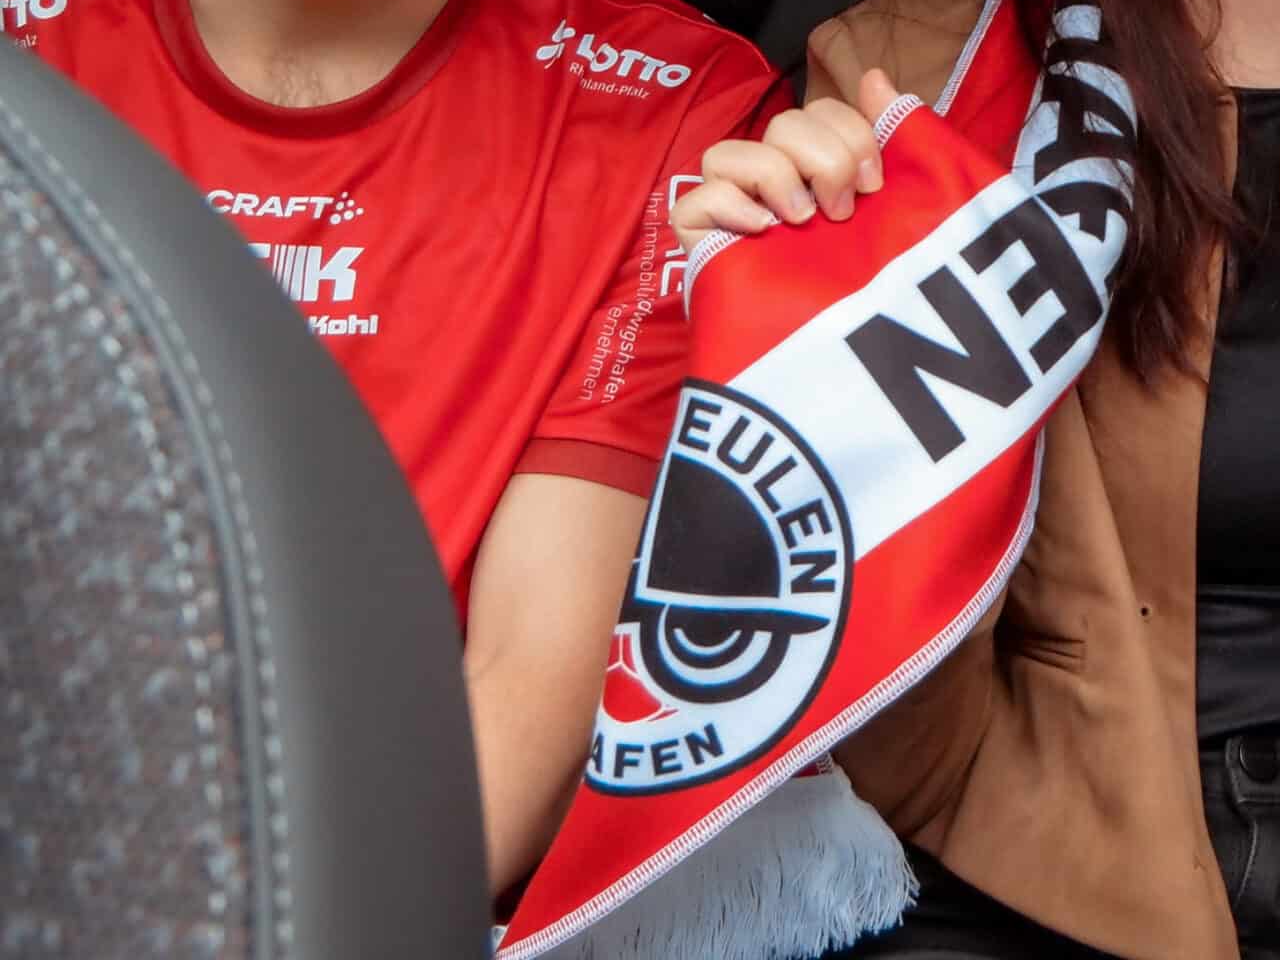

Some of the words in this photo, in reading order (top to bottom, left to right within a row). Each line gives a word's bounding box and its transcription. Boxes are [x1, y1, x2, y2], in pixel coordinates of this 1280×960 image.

[576, 33, 692, 88] LOTTO
[207, 190, 334, 218] CRAFT
[678, 396, 837, 595] EULEN
